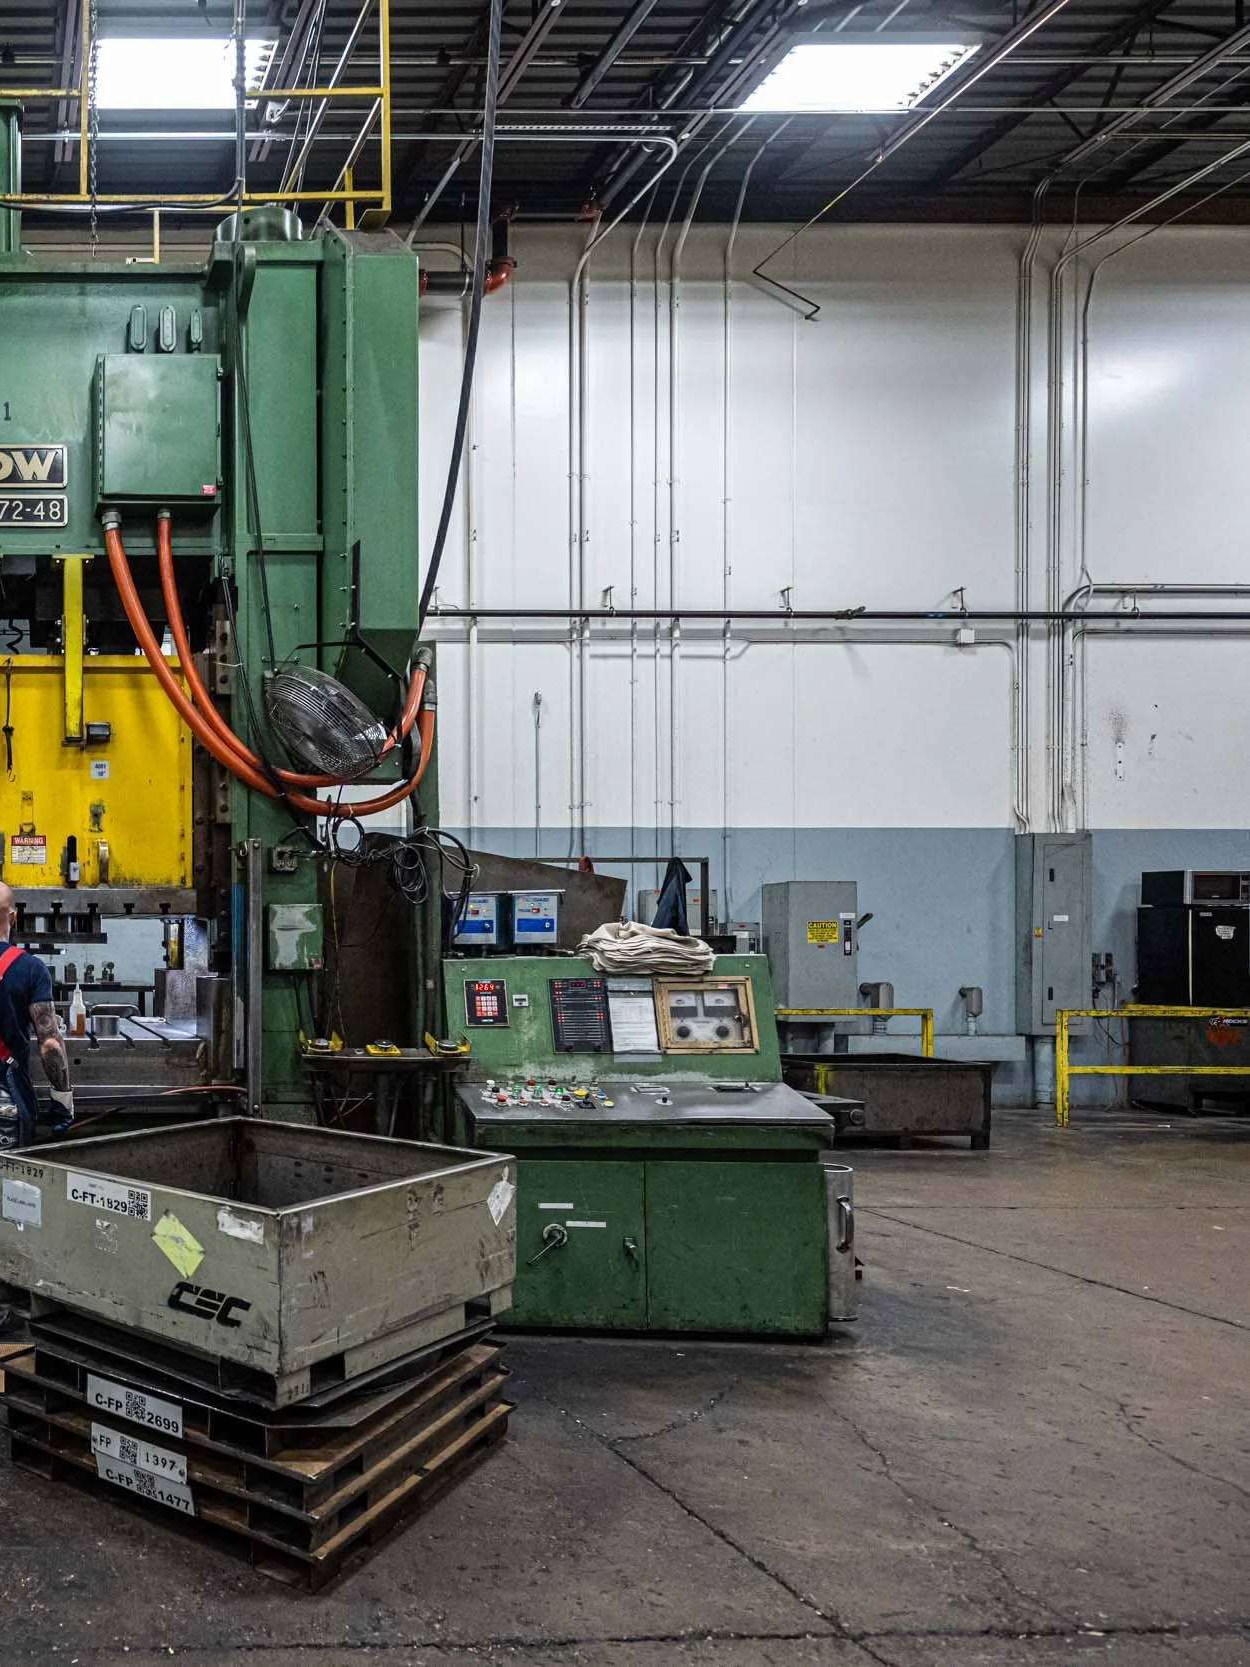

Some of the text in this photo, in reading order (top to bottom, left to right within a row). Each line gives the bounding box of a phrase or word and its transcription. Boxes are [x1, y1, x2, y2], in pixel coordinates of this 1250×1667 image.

[808, 921, 837, 929] CAUTION
[71, 1188, 128, 1213] C-FT-1829
[95, 1392, 180, 1434] C-FP 2699
[99, 1435, 177, 1472] FP 1397
[105, 1468, 190, 1511] C-FP 1477
